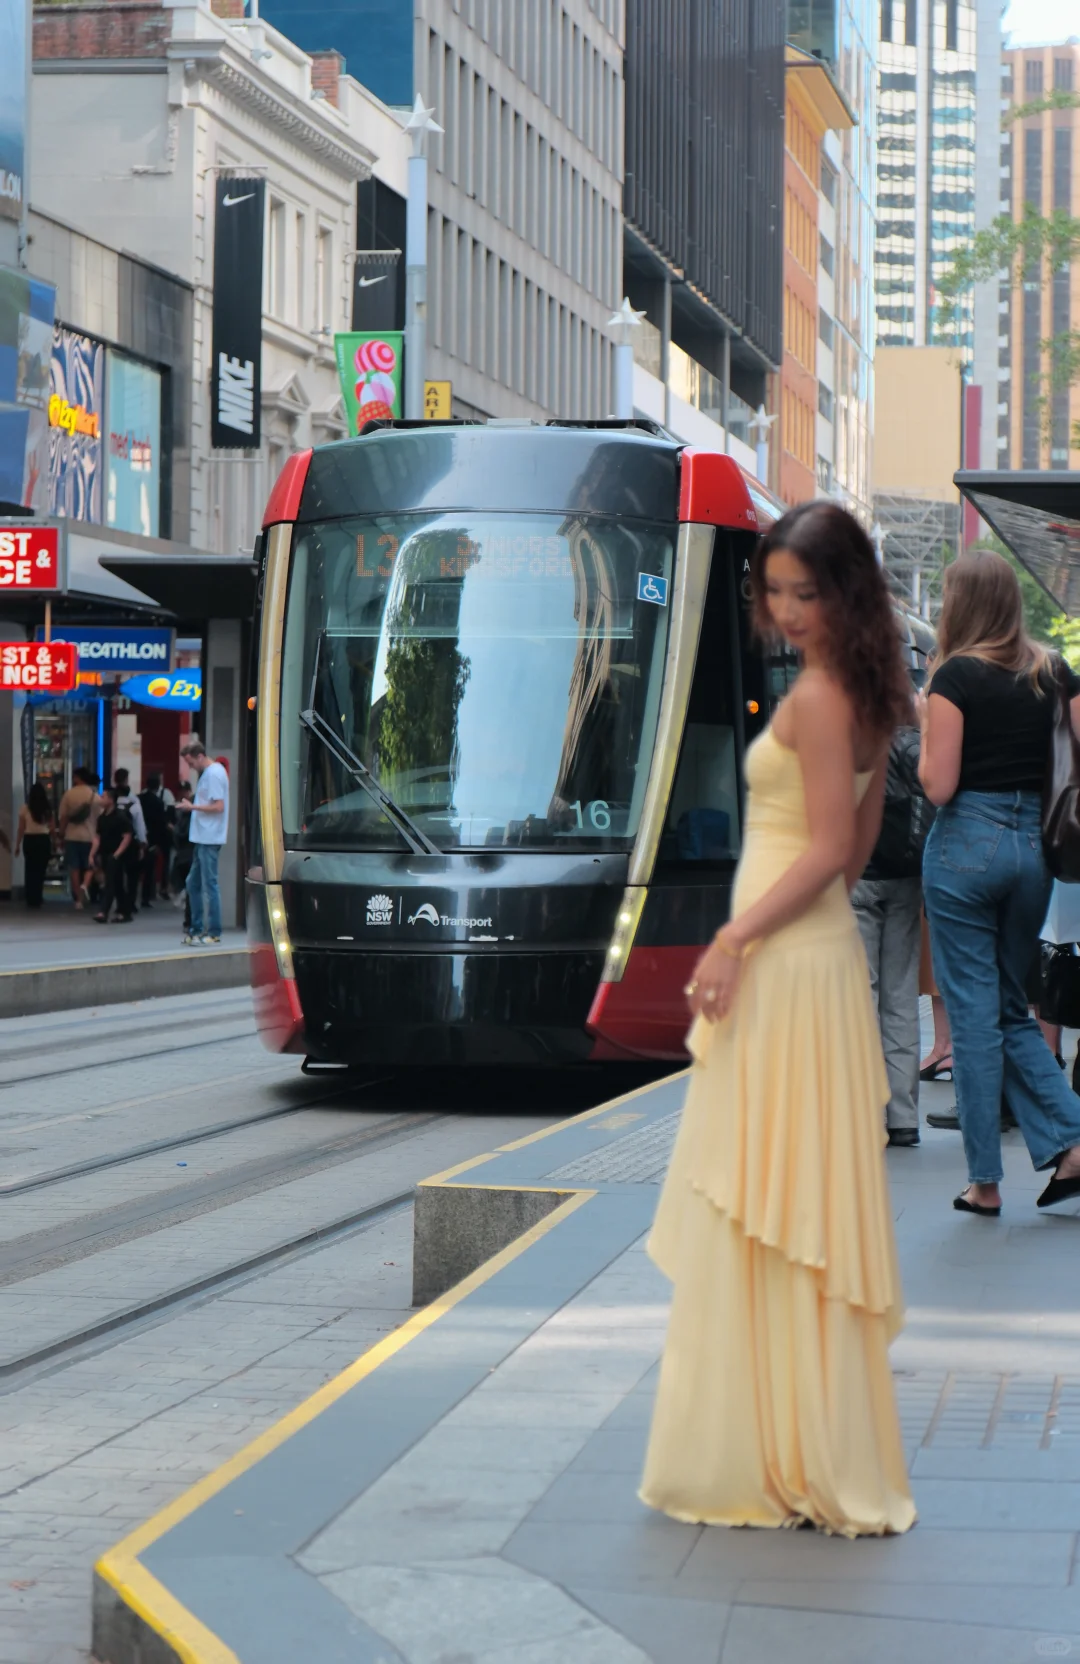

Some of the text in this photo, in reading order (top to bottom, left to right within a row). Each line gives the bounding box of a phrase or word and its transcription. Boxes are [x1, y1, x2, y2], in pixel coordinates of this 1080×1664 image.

[218, 352, 255, 434] NIKE
[426, 386, 439, 418] ART
[36, 548, 52, 569] &
[356, 533, 399, 577] L3
[0, 646, 52, 665] ST &
[0, 665, 53, 685] NCE
[170, 679, 203, 701] Ezy
[569, 800, 611, 830] 16
[366, 911, 393, 922] NSW
[440, 915, 493, 928] Transport
